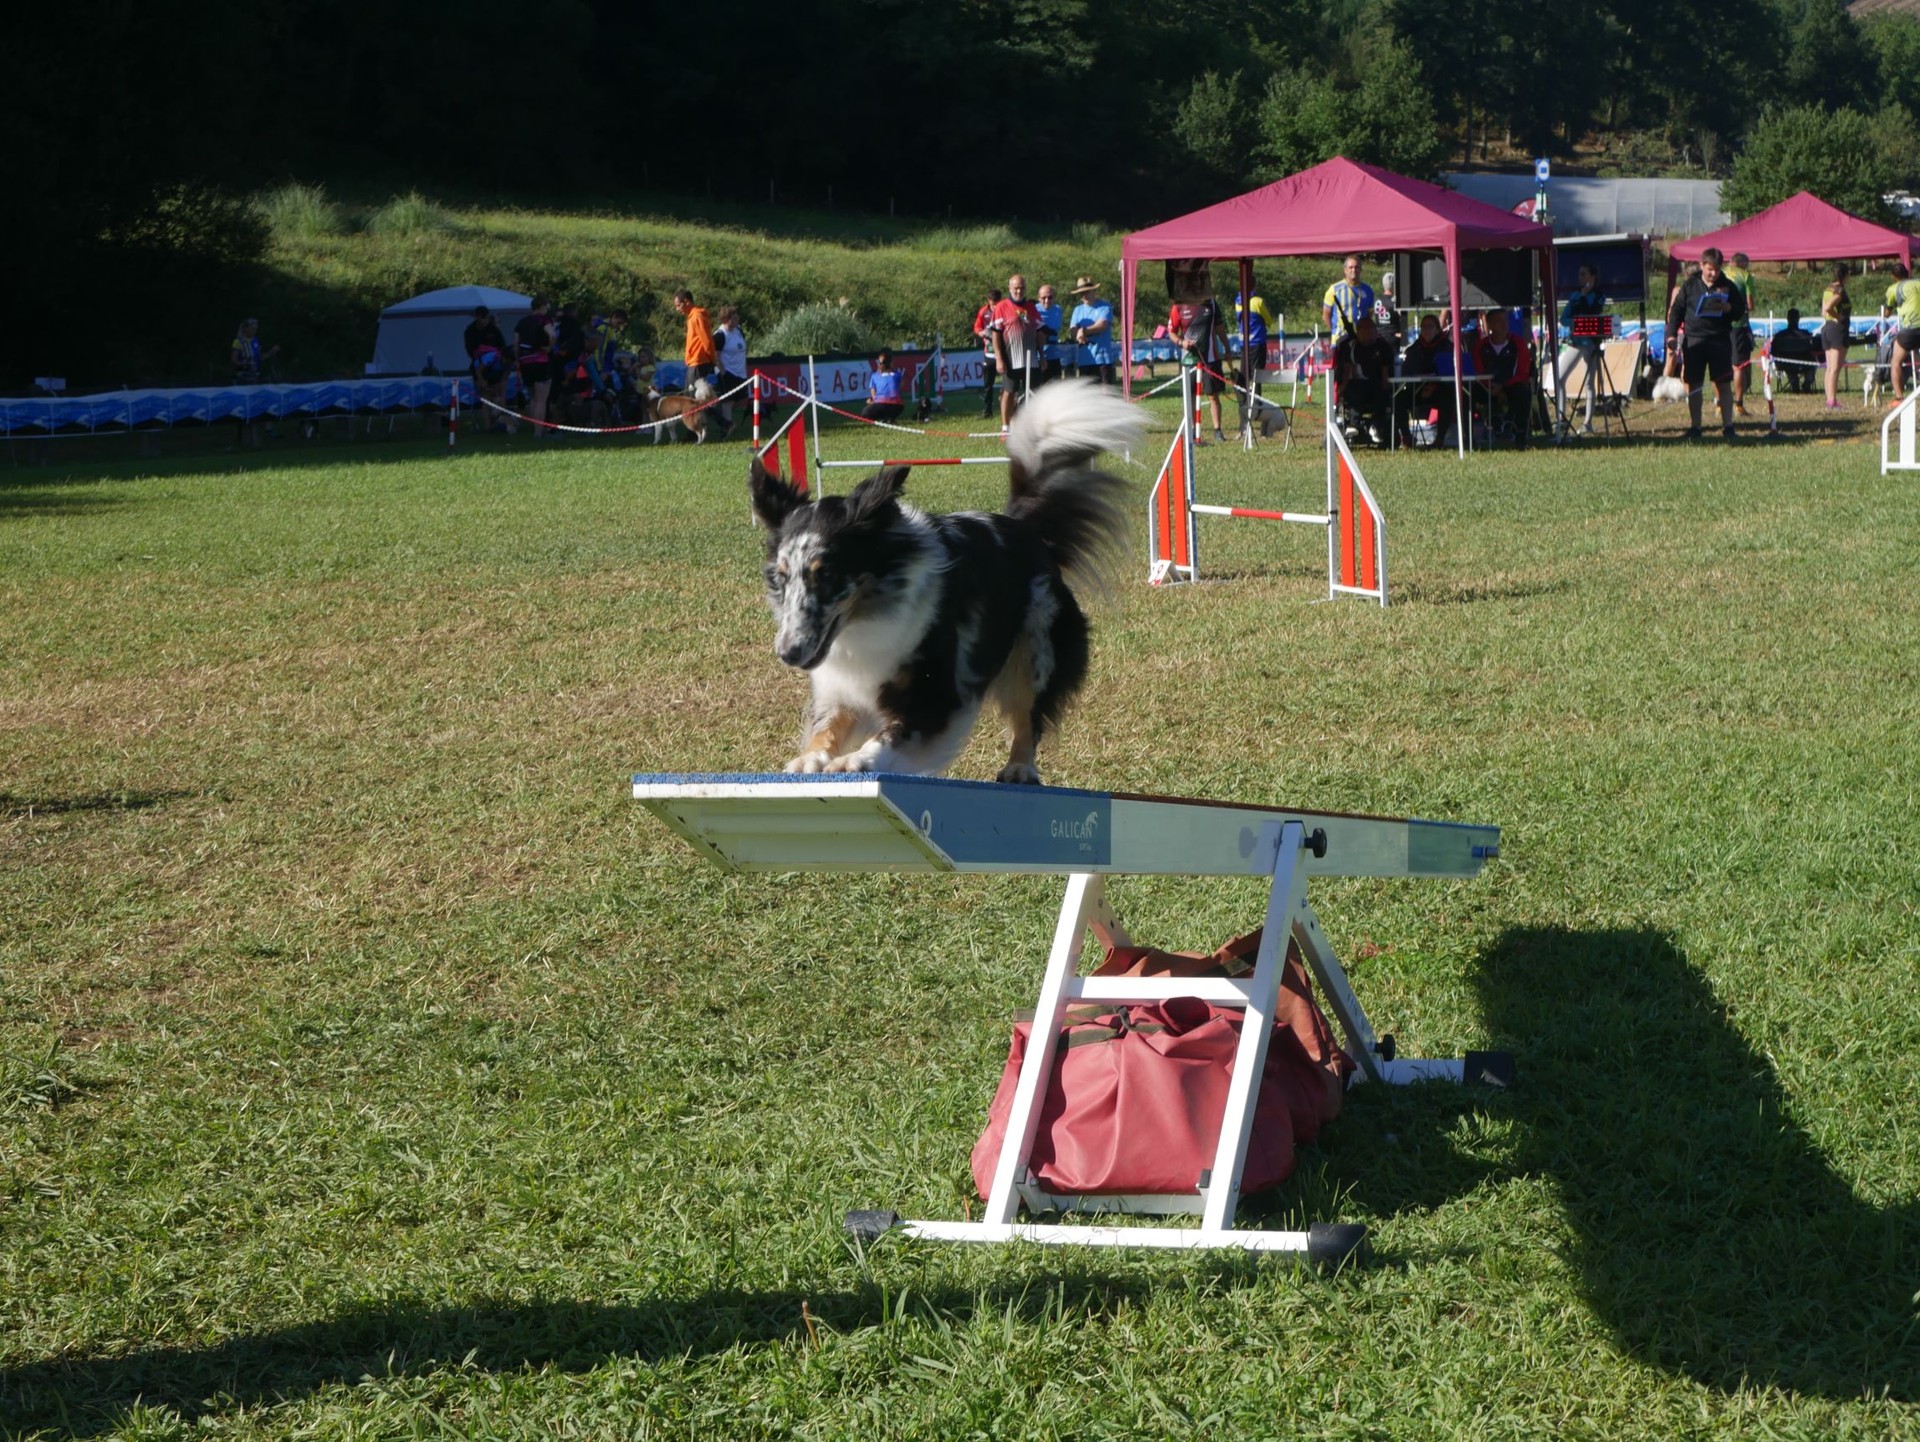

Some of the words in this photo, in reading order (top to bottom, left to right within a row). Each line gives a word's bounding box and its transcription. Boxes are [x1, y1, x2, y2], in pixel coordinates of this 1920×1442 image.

[747, 376, 788, 398] LUB
[915, 361, 984, 385] ESKAD
[1050, 819, 1093, 839] GALICAN
